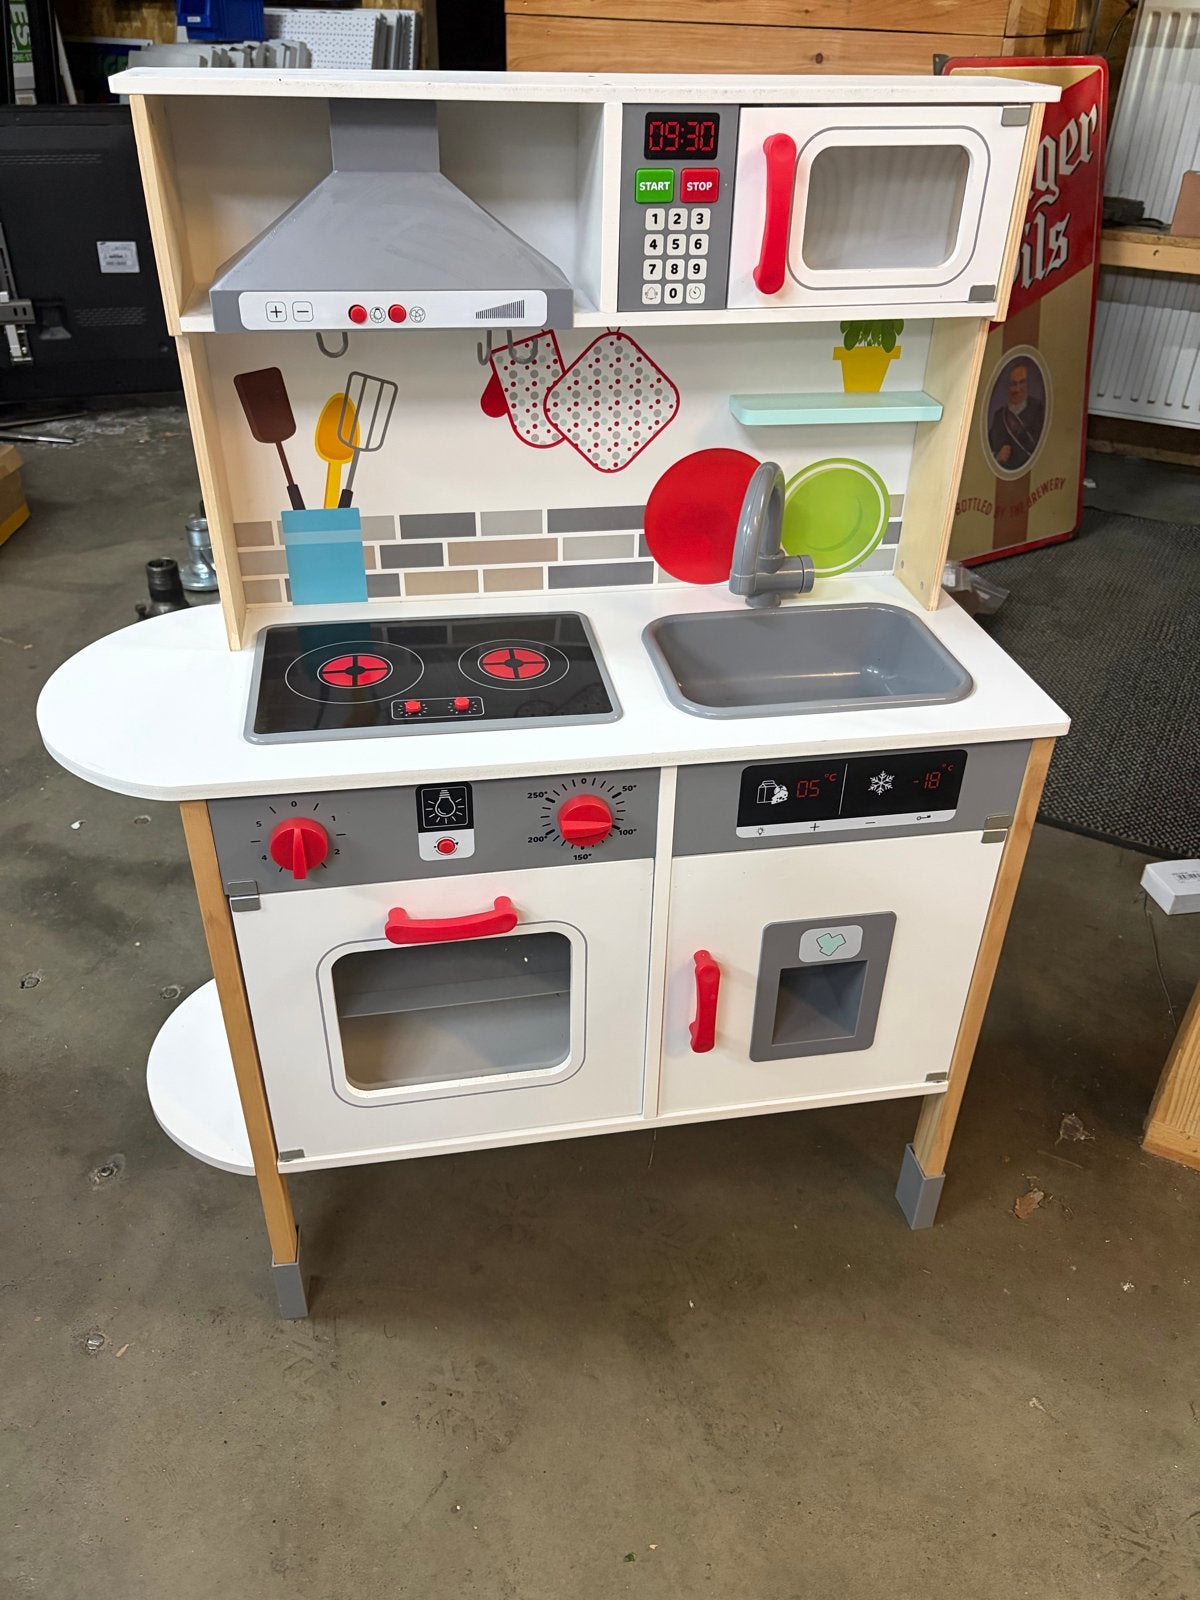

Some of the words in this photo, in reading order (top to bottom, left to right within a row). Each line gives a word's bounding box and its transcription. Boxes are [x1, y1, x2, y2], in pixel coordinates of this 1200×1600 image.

[9, 0, 31, 46] ES
[648, 121, 715, 151] 09:30
[1029, 103, 1098, 213] ger
[639, 181, 670, 191] START
[686, 181, 713, 192] STOP
[651, 213, 658, 224] 1
[672, 213, 682, 224] 2
[696, 212, 704, 224] 3
[649, 238, 658, 250] 4
[672, 238, 680, 250] 5
[694, 238, 702, 250] 6
[1014, 211, 1071, 289] ils
[648, 264, 656, 274] 7
[670, 264, 678, 274] 8
[692, 263, 700, 274] 9
[669, 288, 678, 298] 0
[955, 497, 993, 516] BOTTLED
[1026, 477, 1066, 509] BREWERY
[796, 779, 820, 798] 05
